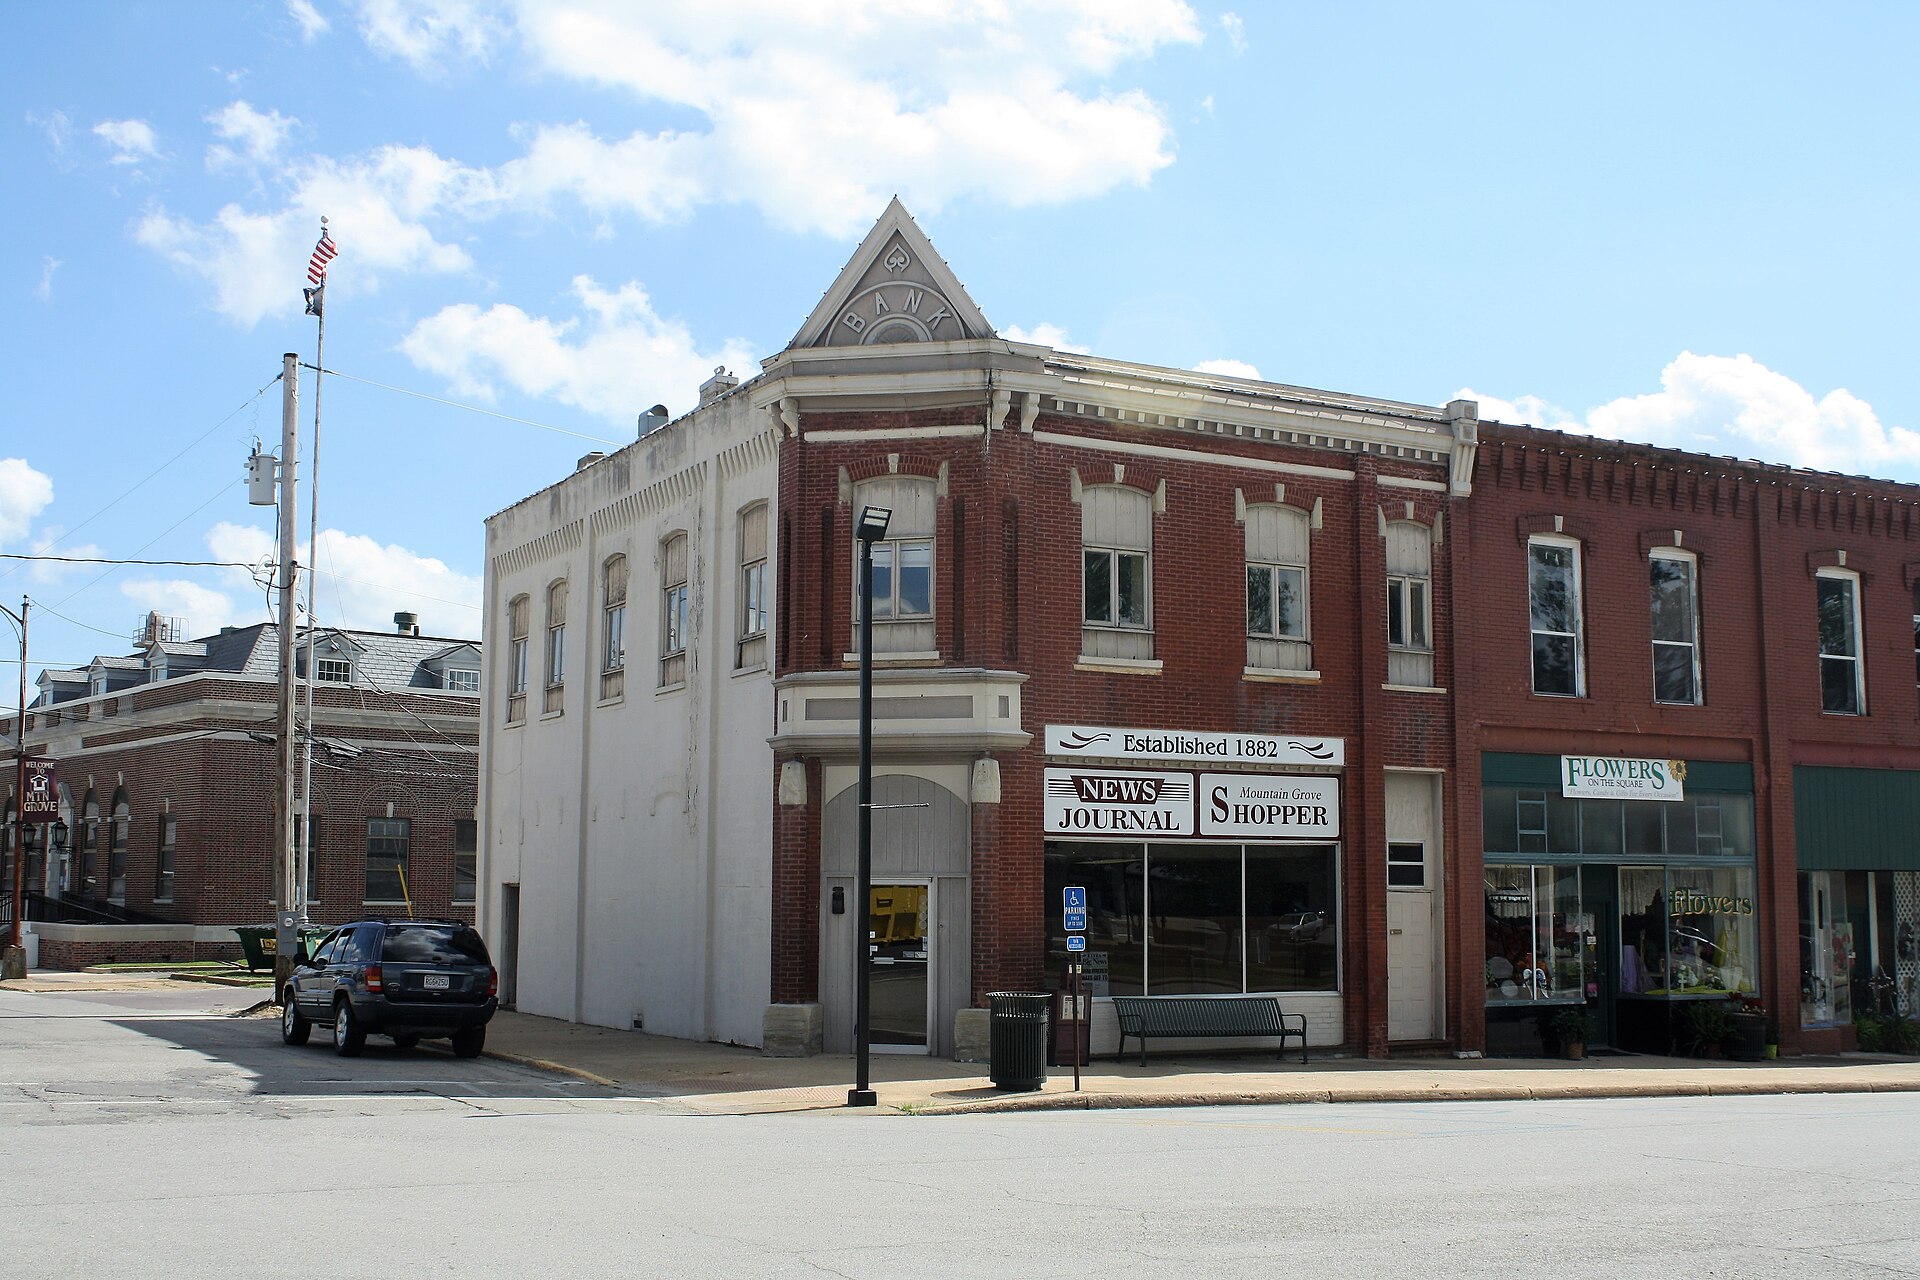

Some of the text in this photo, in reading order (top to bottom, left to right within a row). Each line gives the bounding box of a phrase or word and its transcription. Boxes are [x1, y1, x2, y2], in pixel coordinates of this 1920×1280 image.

[842, 289, 952, 334] BANK
[1123, 734, 1279, 758] Established 1882
[25, 761, 55, 769] WELCOME
[1566, 757, 1665, 790] FLOWERS
[1080, 778, 1157, 802] NEWS
[1588, 778, 1644, 788] ON THE SQUARE
[26, 791, 50, 801] MTN
[1240, 787, 1322, 800] Mountain Grove
[24, 801, 57, 812] GROVE
[1210, 786, 1329, 826] SHOPPER
[1059, 807, 1180, 831] JOURNAL
[1065, 906, 1085, 914] PARKING
